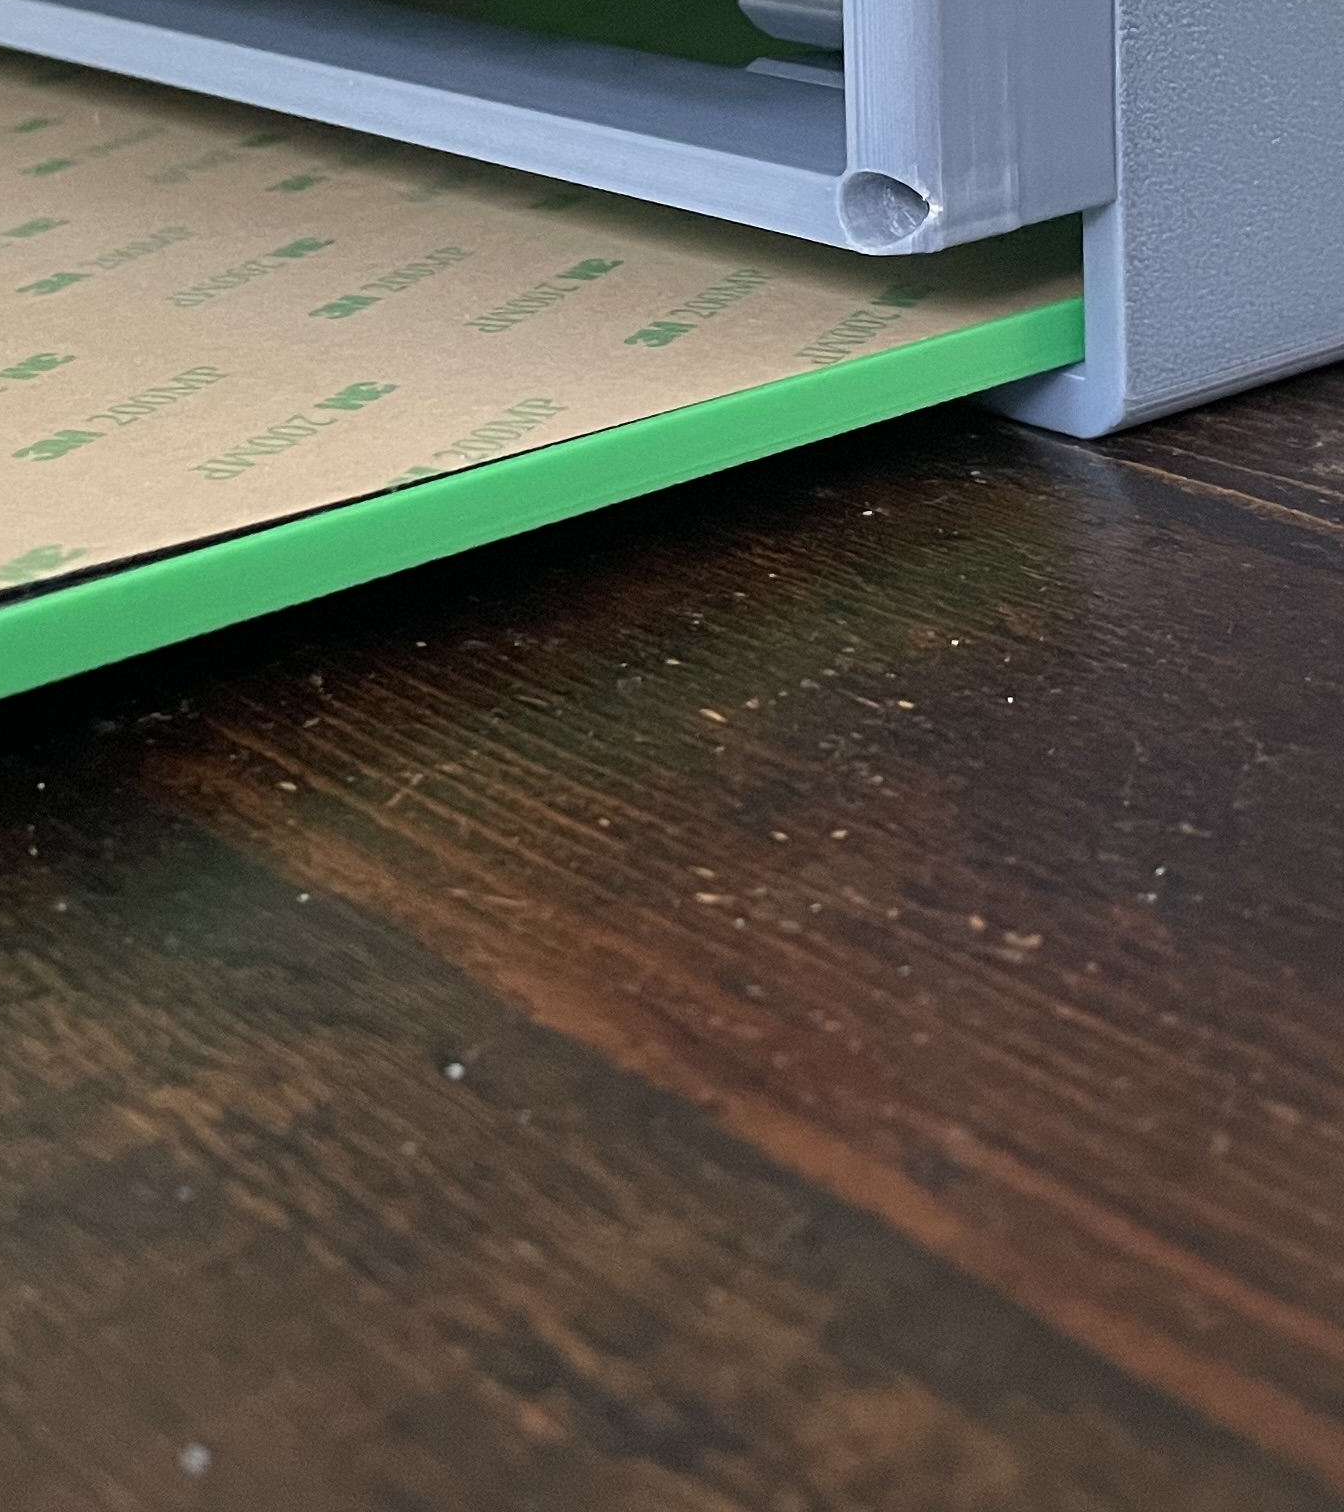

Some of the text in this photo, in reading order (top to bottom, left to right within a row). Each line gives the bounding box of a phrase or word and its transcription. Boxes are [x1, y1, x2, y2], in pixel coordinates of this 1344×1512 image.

[466, 284, 581, 333] 200MP
[668, 266, 771, 319] 200MP
[84, 366, 228, 426] 200MP
[189, 414, 337, 480] 200MP
[432, 398, 569, 461] 200MP
